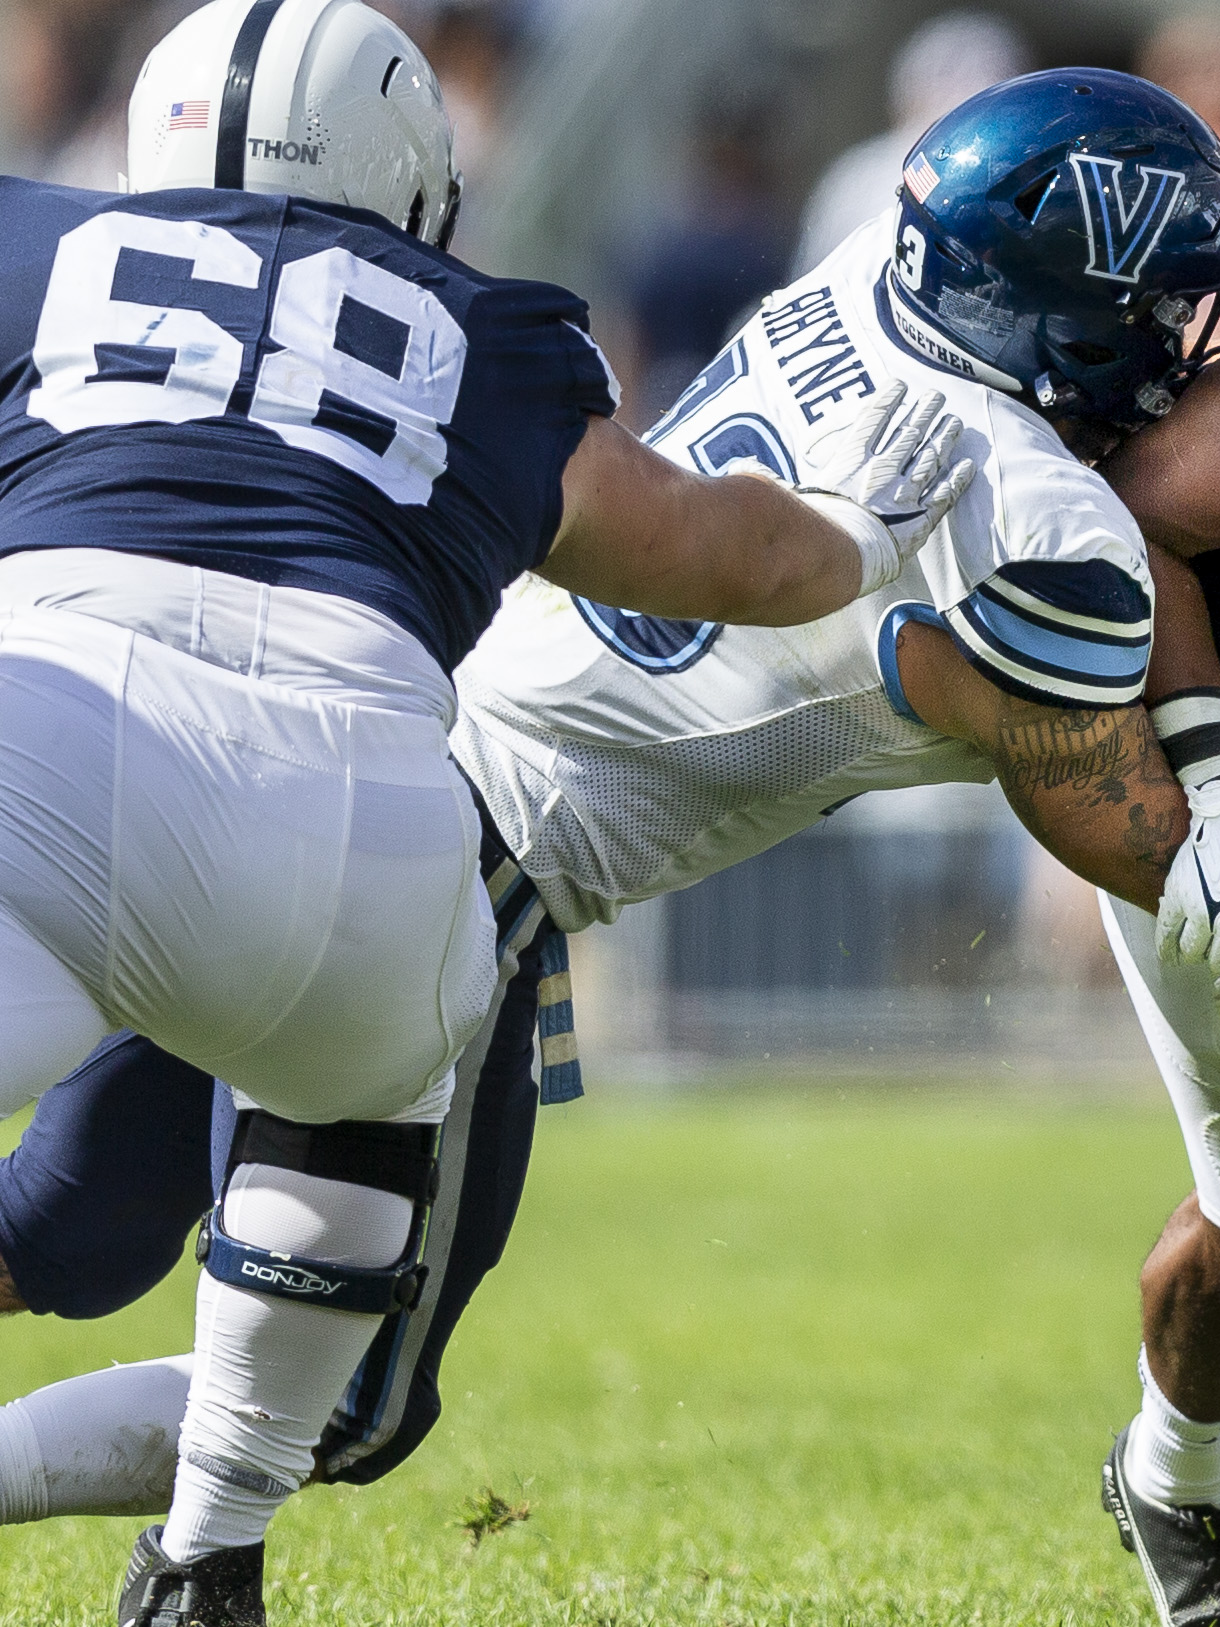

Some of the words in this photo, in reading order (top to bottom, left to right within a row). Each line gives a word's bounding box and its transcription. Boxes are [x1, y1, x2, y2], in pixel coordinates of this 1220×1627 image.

[248, 138, 319, 165] THON
[1066, 151, 1186, 283] V
[26, 211, 468, 507] 68
[895, 310, 976, 377] TOGETHER
[241, 1260, 342, 1295] DONJOY
